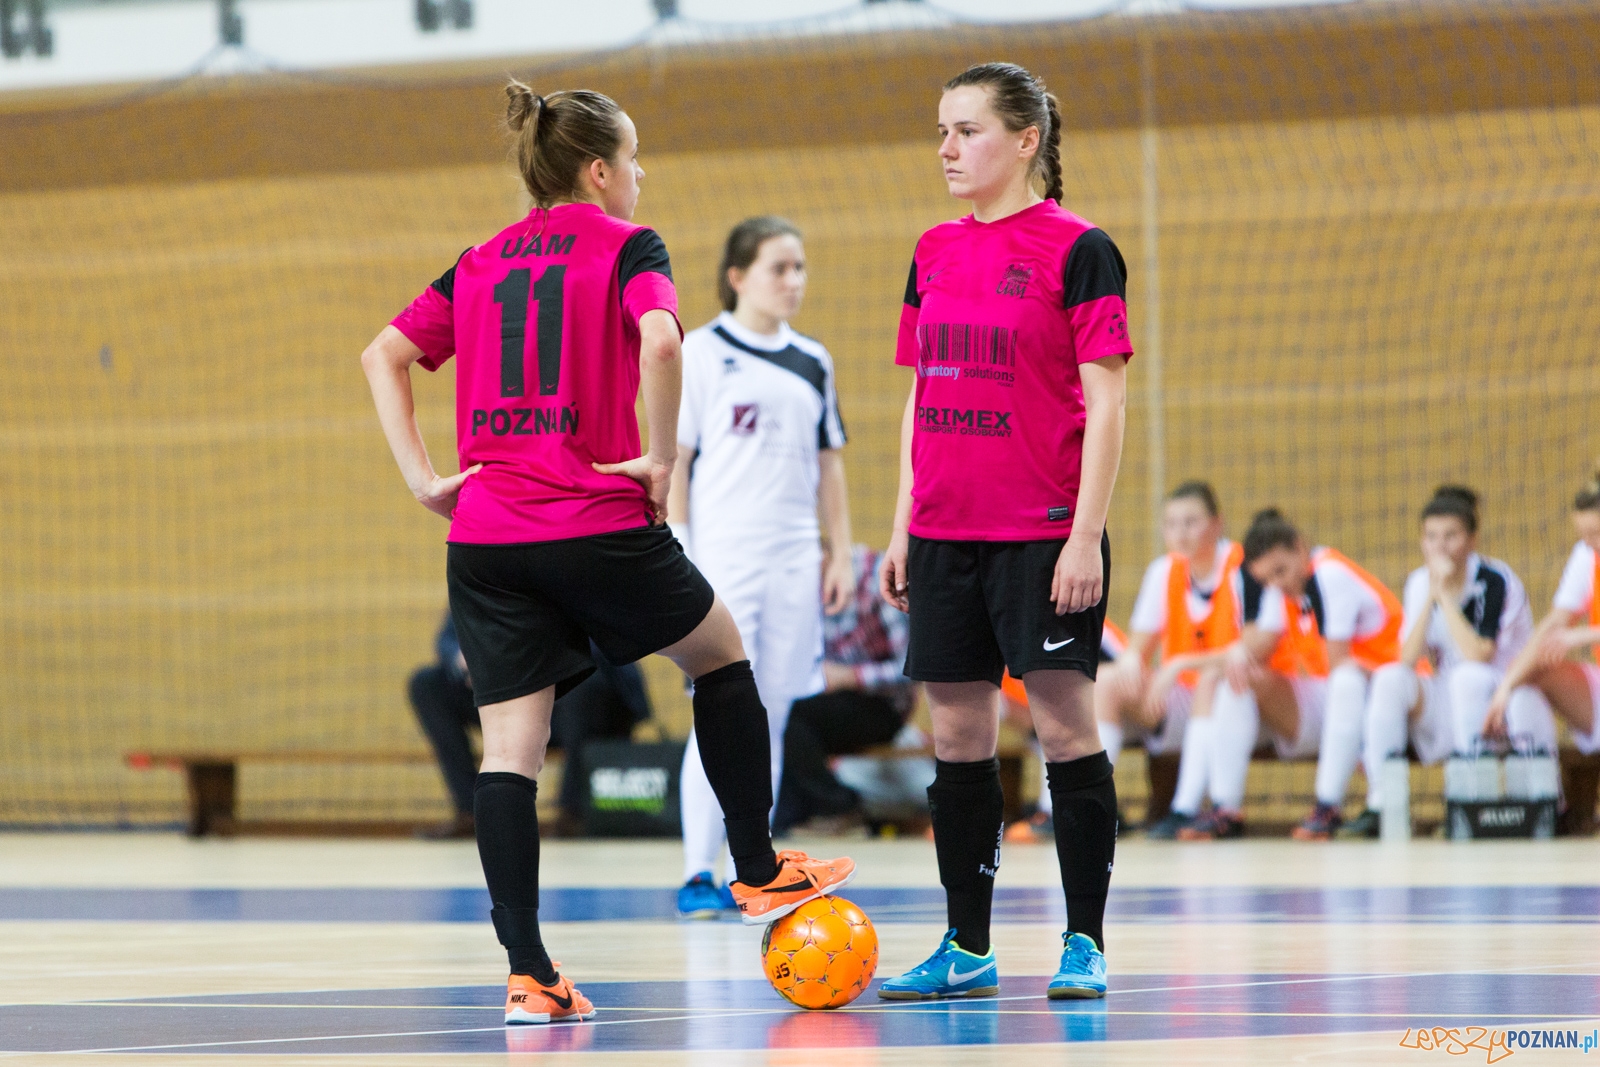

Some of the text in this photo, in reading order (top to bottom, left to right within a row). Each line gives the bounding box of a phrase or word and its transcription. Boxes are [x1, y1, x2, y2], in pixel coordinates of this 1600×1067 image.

[499, 233, 578, 259] UAM
[493, 264, 568, 398] 11
[963, 366, 1016, 382] solutions
[471, 401, 580, 437] POZNAŃ
[918, 406, 1013, 431] PRIMEX
[959, 427, 1013, 438] OSOBOWY
[510, 994, 528, 1004] NIKE
